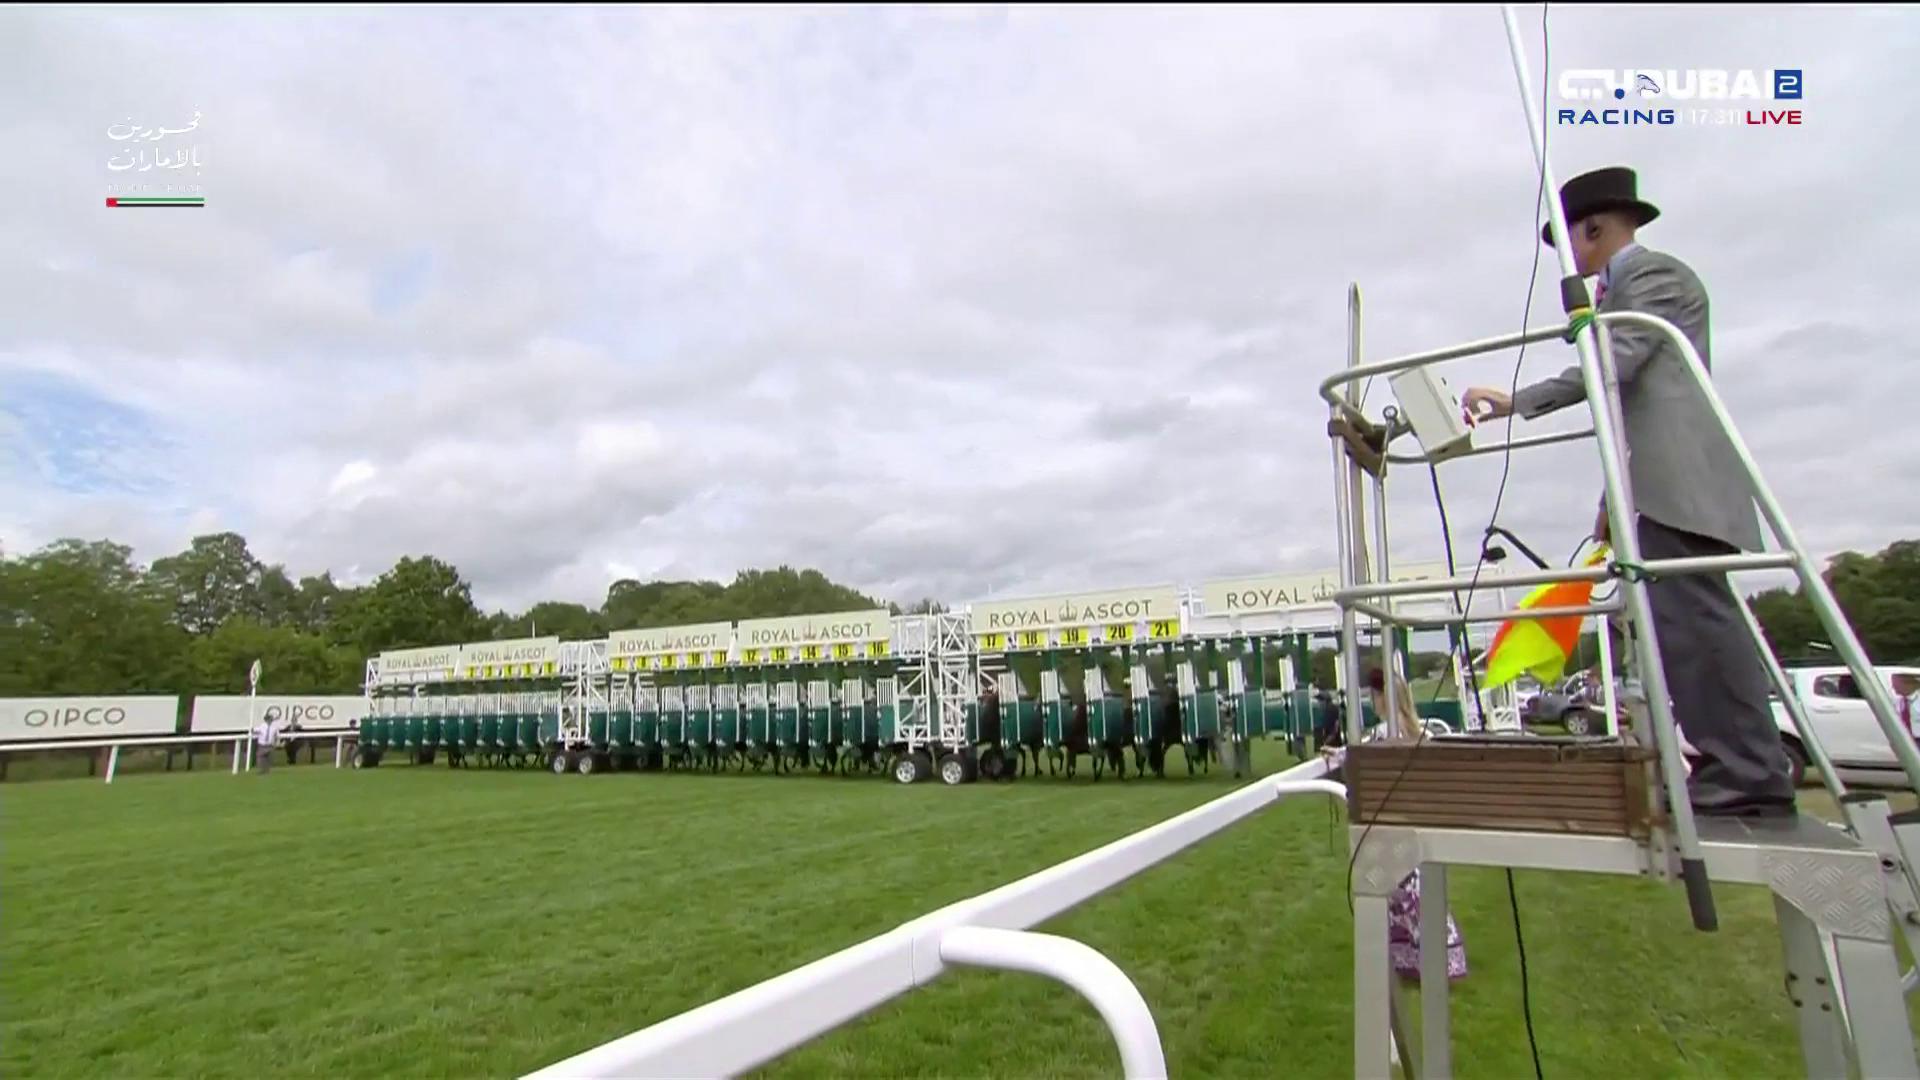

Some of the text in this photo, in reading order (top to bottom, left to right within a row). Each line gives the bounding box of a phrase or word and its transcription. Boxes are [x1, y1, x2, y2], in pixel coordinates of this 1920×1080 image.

[1226, 588, 1307, 610] ROYAL
[989, 599, 1152, 629] ROYAL ASCOT
[751, 622, 873, 644] ROYAL ASCOT
[1066, 628, 1079, 642] 19
[1110, 624, 1126, 639] 20
[1155, 621, 1170, 637] 21
[619, 633, 718, 653] ROYAL ASCOT
[986, 633, 997, 647] 17
[1025, 631, 1038, 645] 18
[470, 646, 547, 663] ROYAL ASCOT
